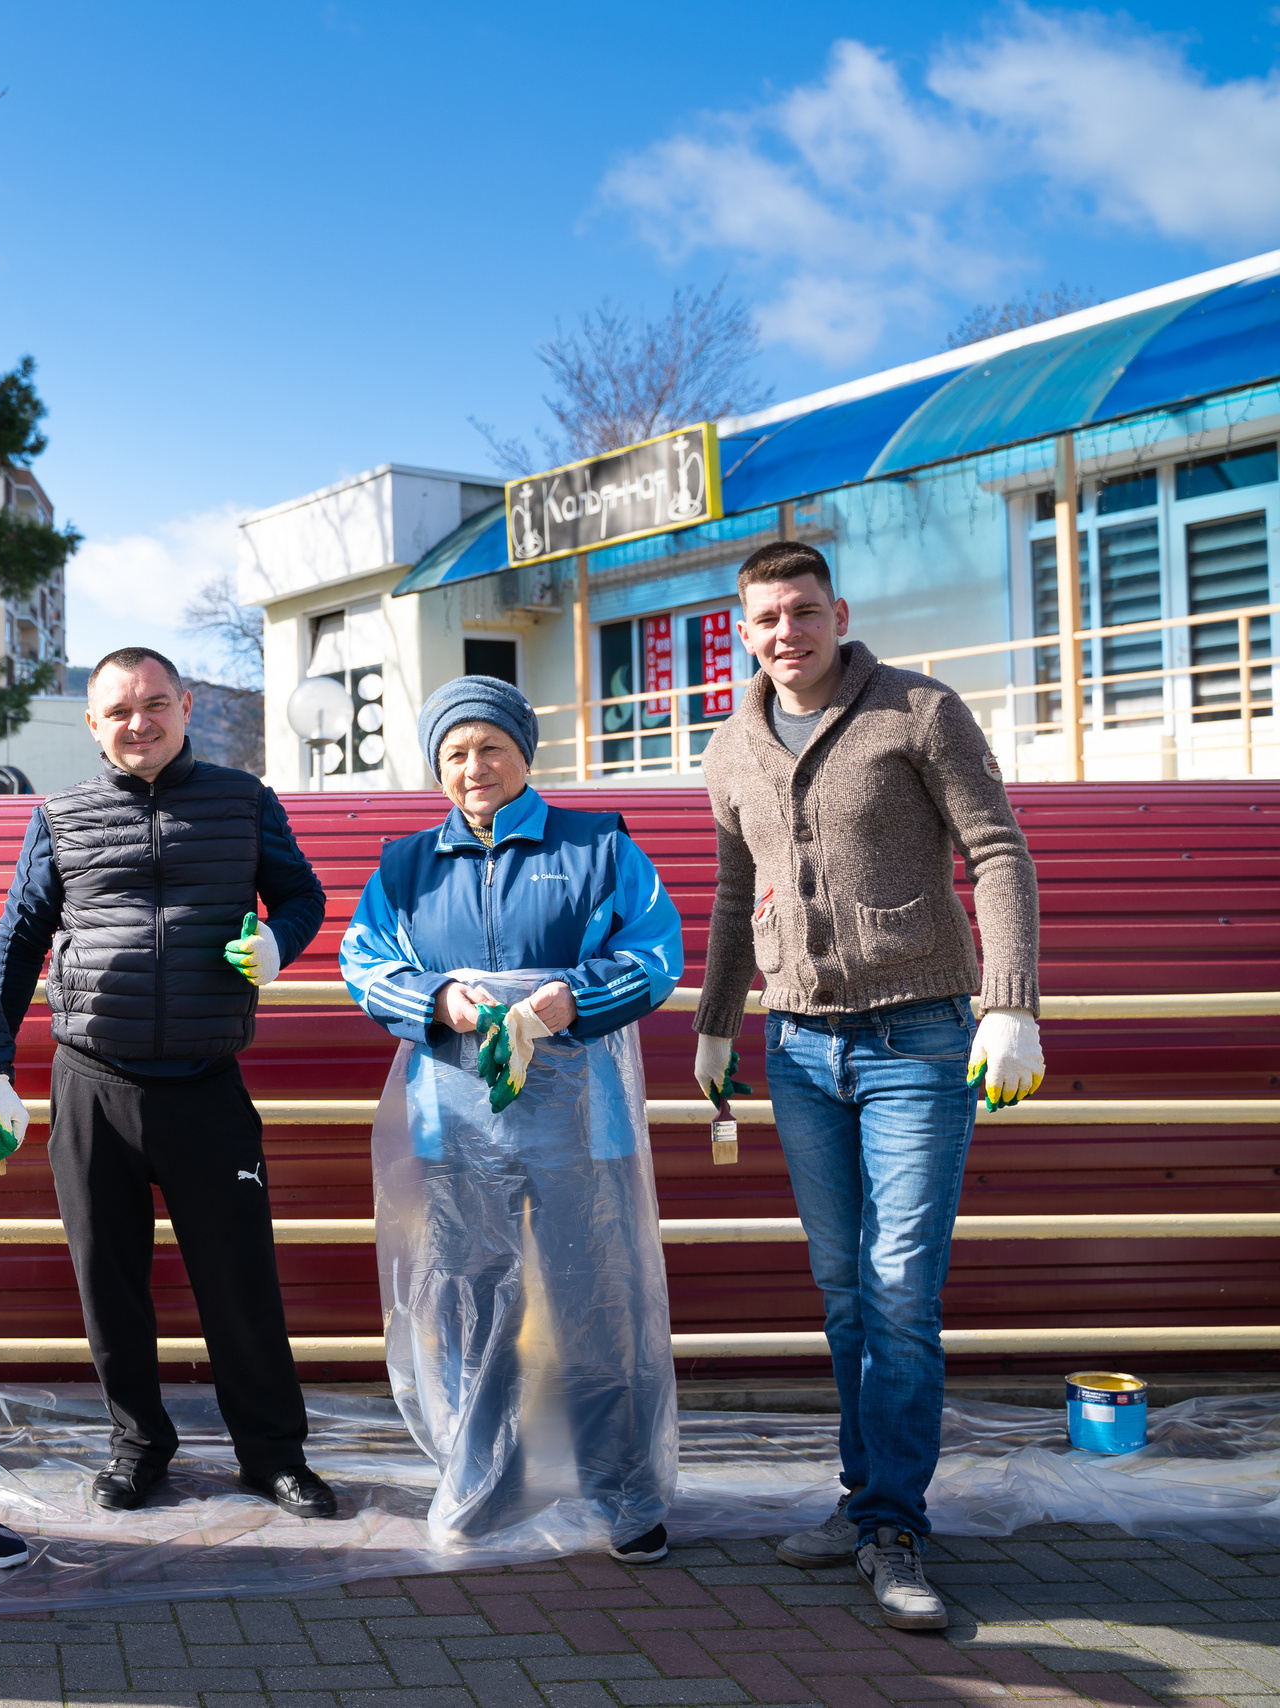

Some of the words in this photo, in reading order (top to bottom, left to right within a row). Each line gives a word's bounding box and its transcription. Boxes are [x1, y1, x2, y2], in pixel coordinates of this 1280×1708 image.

[718, 614, 726, 630] 8
[656, 637, 671, 653] 918
[714, 633, 731, 651] 918
[715, 654, 731, 670] 368
[718, 694, 731, 710] 96
[540, 873, 570, 881] Columbia
